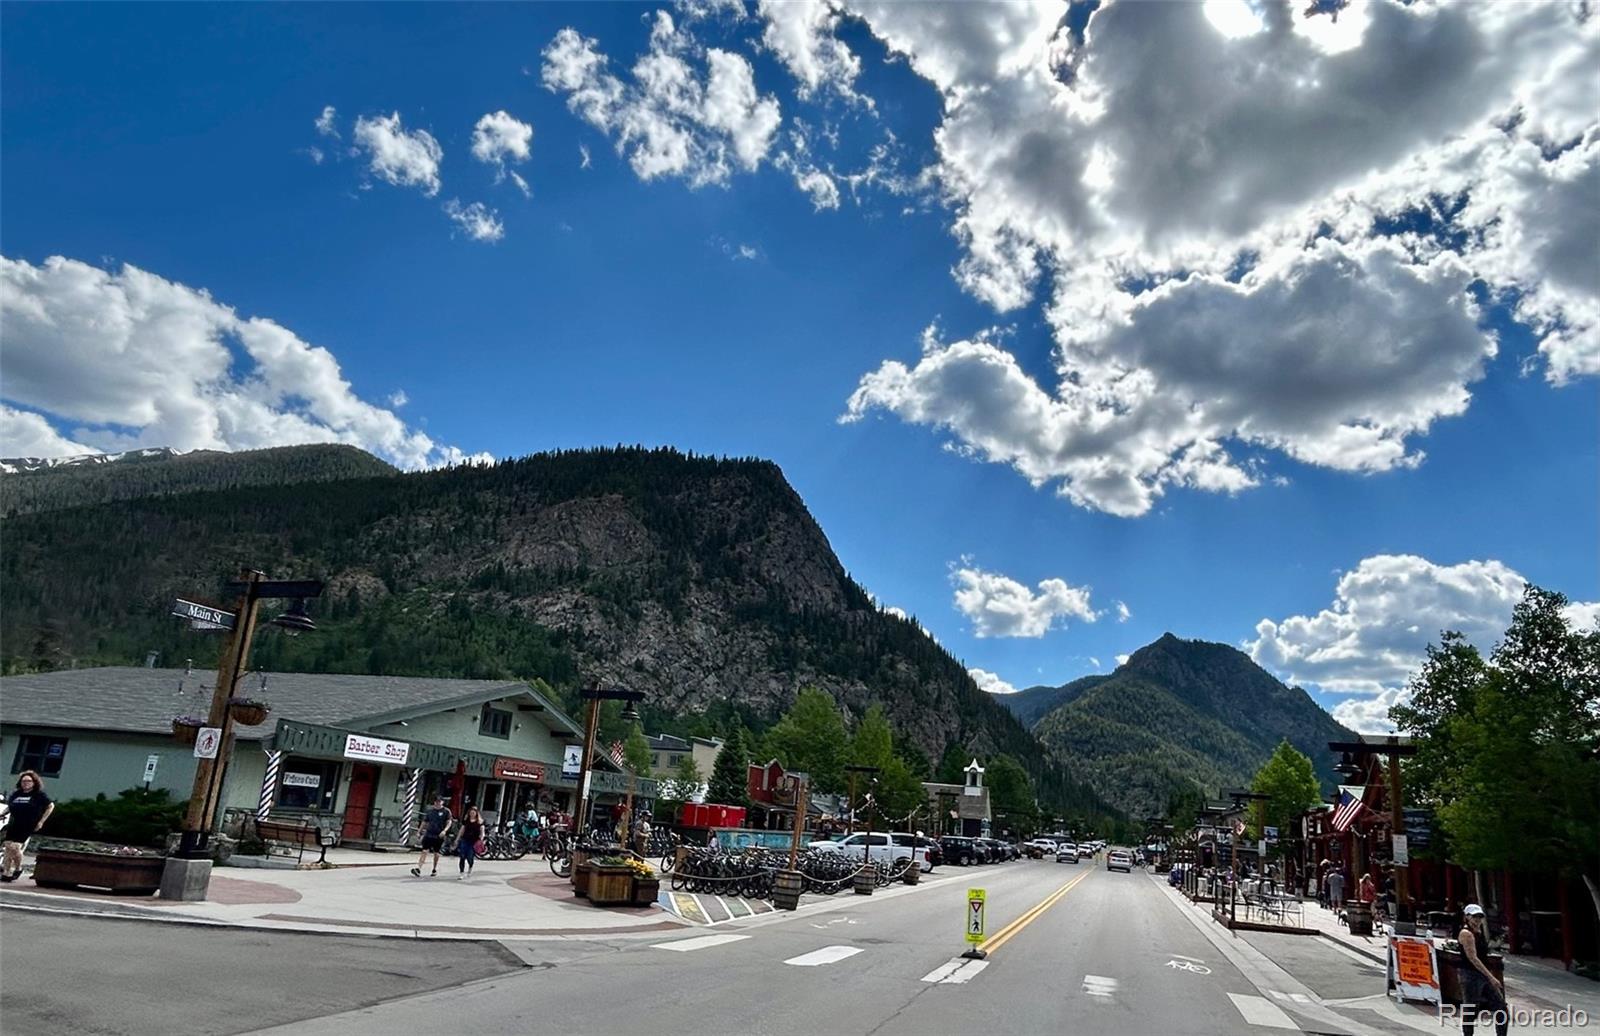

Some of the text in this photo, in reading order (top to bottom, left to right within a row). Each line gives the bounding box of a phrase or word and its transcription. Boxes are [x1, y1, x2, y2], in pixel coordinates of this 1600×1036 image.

[188, 605, 221, 623] Main St
[348, 738, 406, 761] Barber Shop
